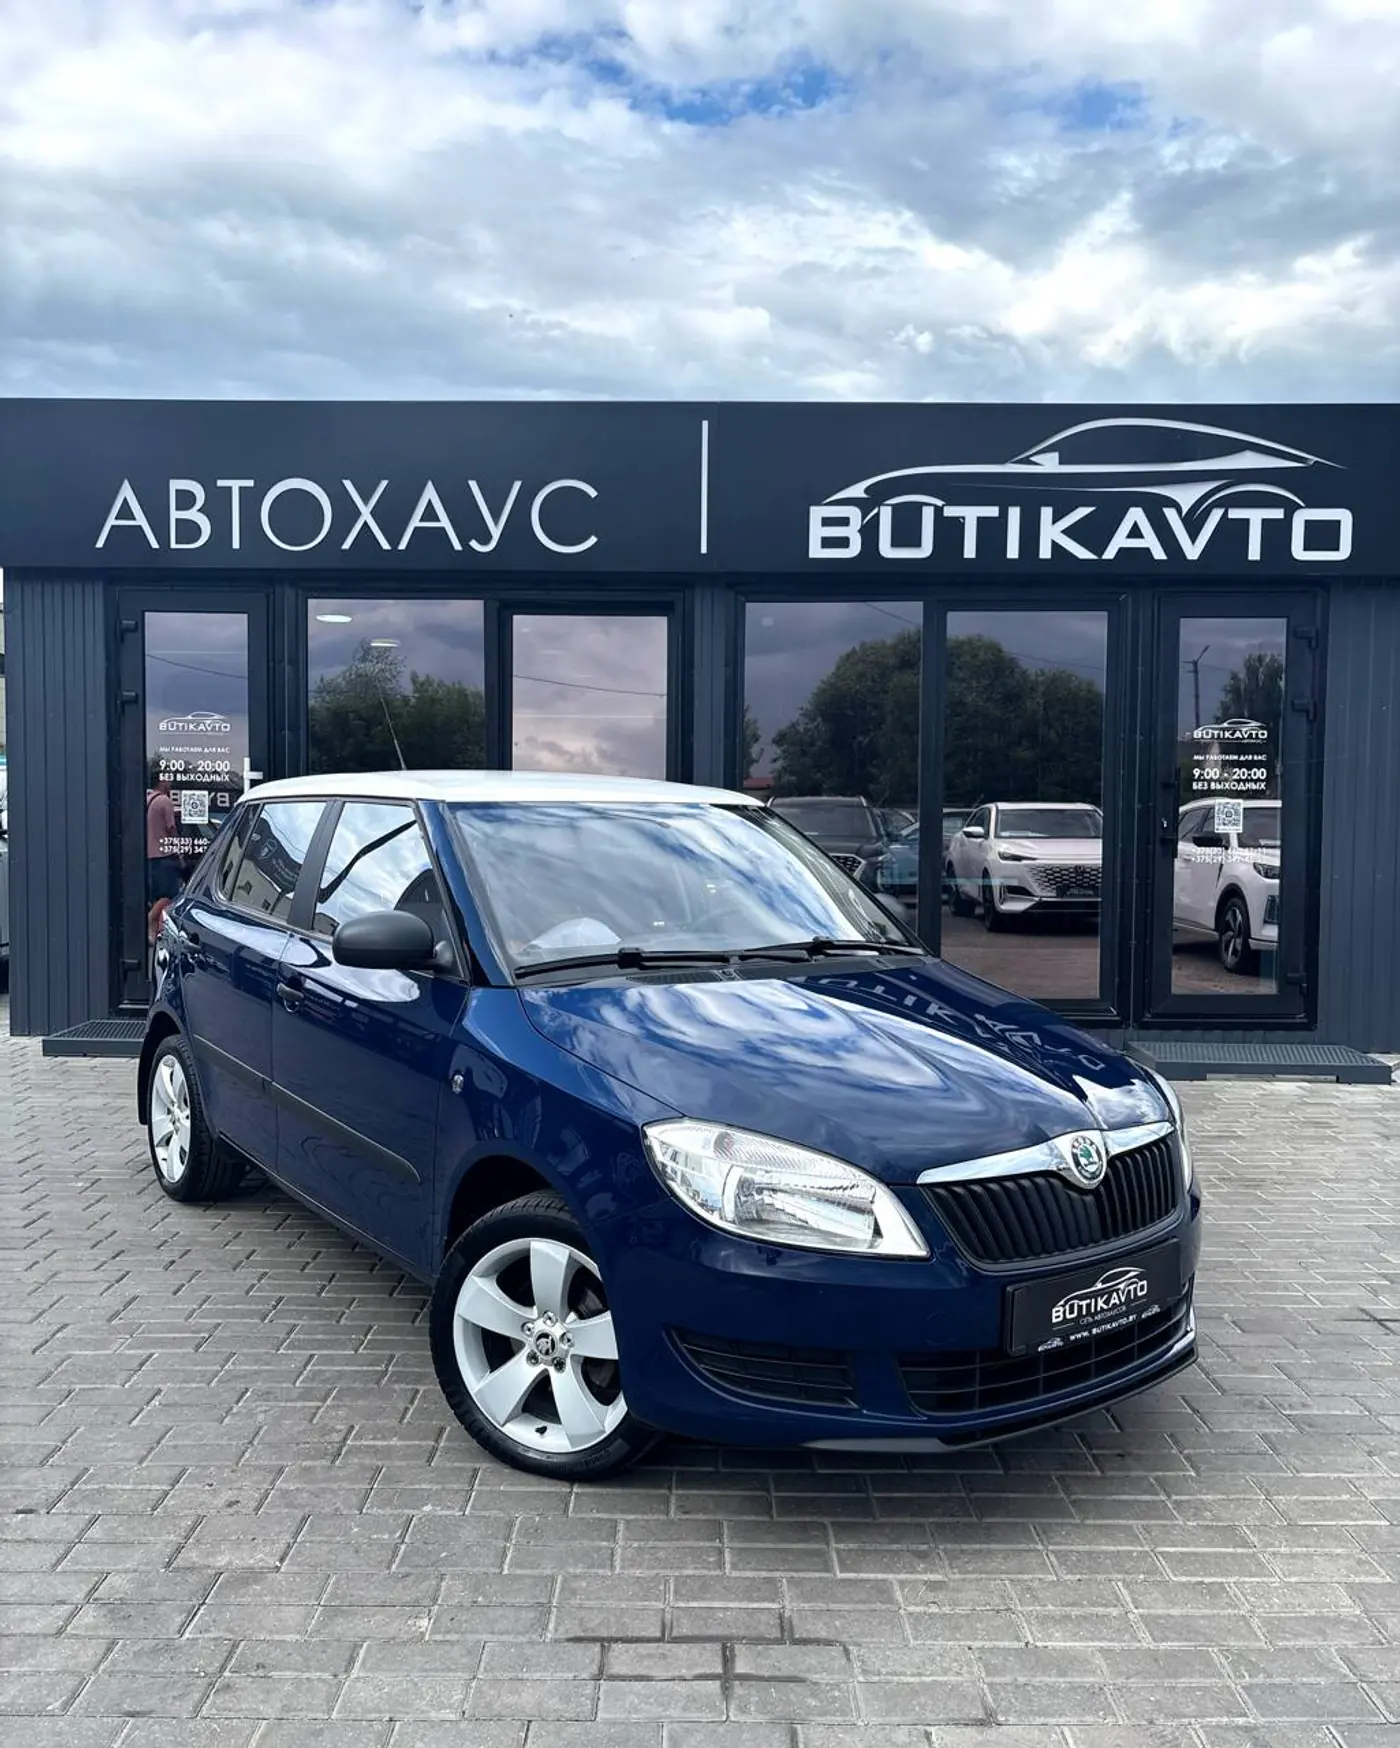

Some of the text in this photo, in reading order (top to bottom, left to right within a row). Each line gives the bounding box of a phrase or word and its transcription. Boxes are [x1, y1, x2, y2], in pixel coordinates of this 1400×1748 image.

[95, 478, 599, 553] АВТОХАУС
[808, 505, 1354, 562] BUTIKAVTO
[159, 721, 231, 732] BUTIKAVTO
[1193, 730, 1268, 739] BUTIKAVTO
[159, 759, 185, 771] 9:00
[197, 760, 231, 772] 20:00
[159, 772, 230, 783] БЕЗ ВЫХОДНЫХ
[1192, 767, 1220, 780] 9:00
[1232, 767, 1267, 780] 20:00
[1192, 781, 1266, 791] БЕЗ ВЫХОДНЫХ
[1051, 1279, 1148, 1324] BUTIKAVTO
